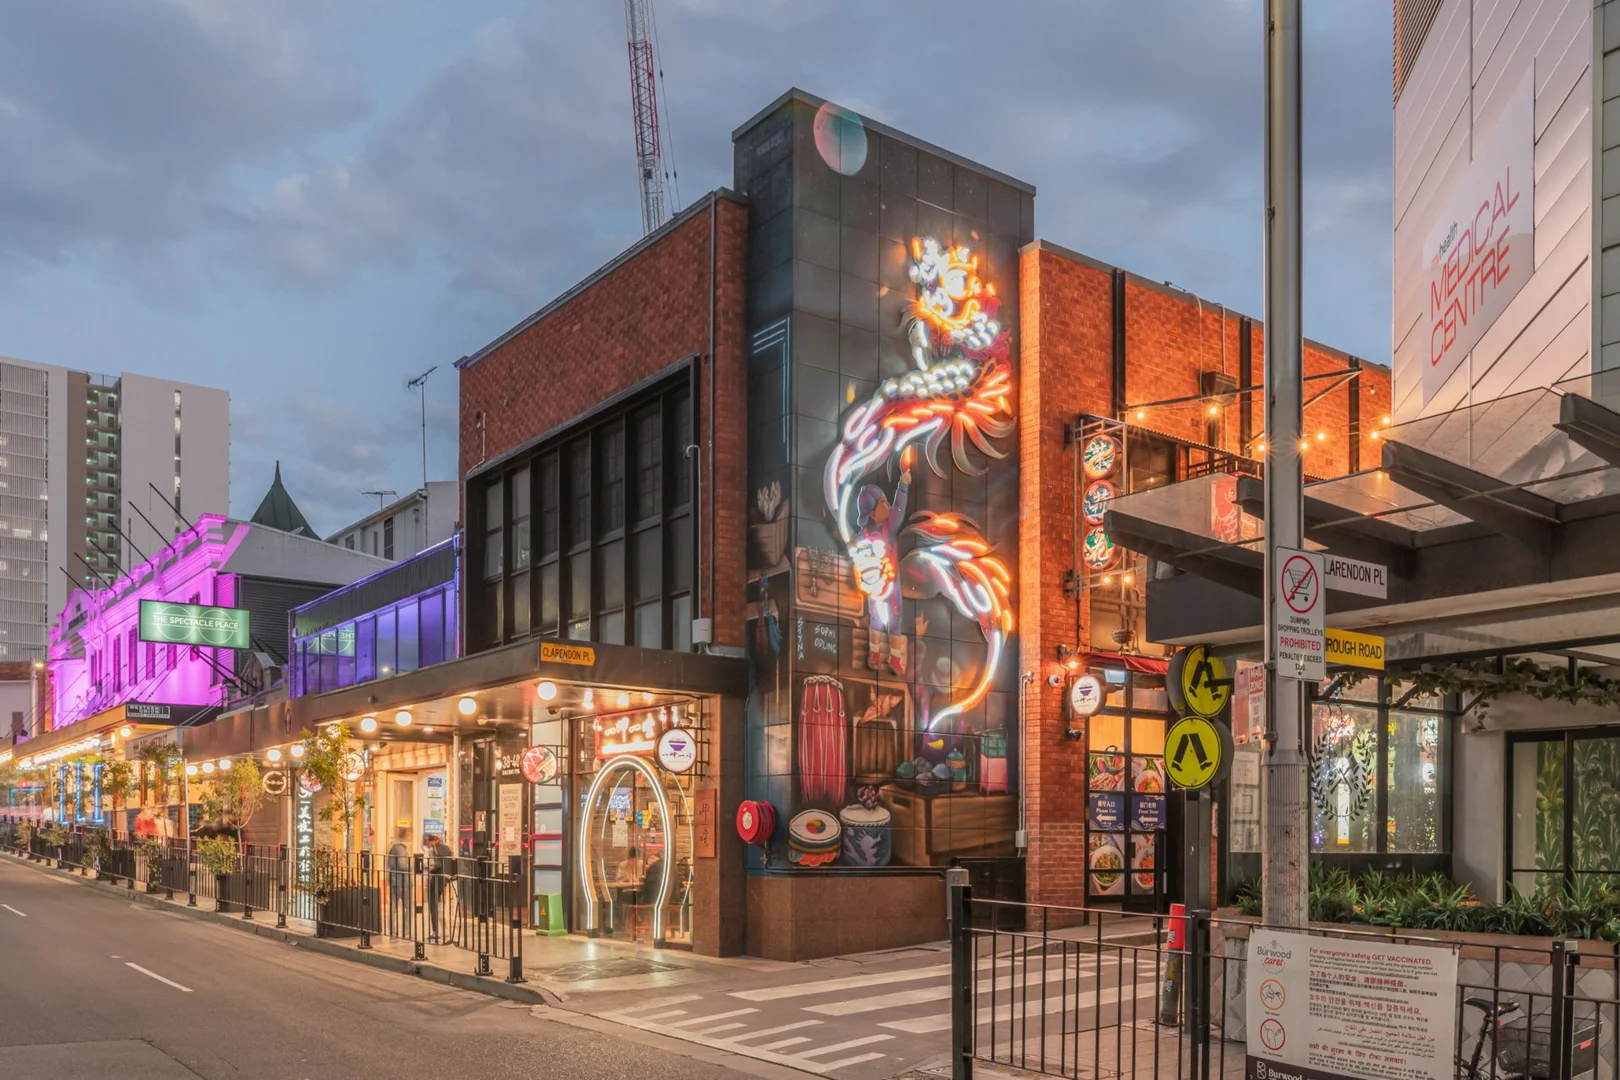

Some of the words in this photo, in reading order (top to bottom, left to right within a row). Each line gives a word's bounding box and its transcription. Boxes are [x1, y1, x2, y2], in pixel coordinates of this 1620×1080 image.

[1430, 166, 1520, 322] MEDICAL
[1431, 225, 1510, 366] CENTRE
[1374, 568, 1384, 586] PL
[154, 615, 166, 624] THE
[170, 616, 213, 628] SPECTACLE
[215, 620, 239, 630] PLACE
[1290, 616, 1310, 626] DUMPING
[1278, 624, 1300, 634] SHOPPING
[1300, 627, 1323, 636] TROLLEYS
[1280, 636, 1321, 651] PROHIBITED
[1326, 638, 1356, 656] ROUGH
[1358, 643, 1382, 659] ROAD
[543, 647, 580, 660] CLARENDON
[583, 652, 591, 661] PL
[1304, 654, 1322, 664] EXCEED
[1257, 946, 1291, 959] Burwood
[1320, 949, 1350, 958] everyone's
[1351, 952, 1370, 960] safety
[1264, 957, 1284, 966] cares
[1268, 1068, 1302, 1080] Burwood
